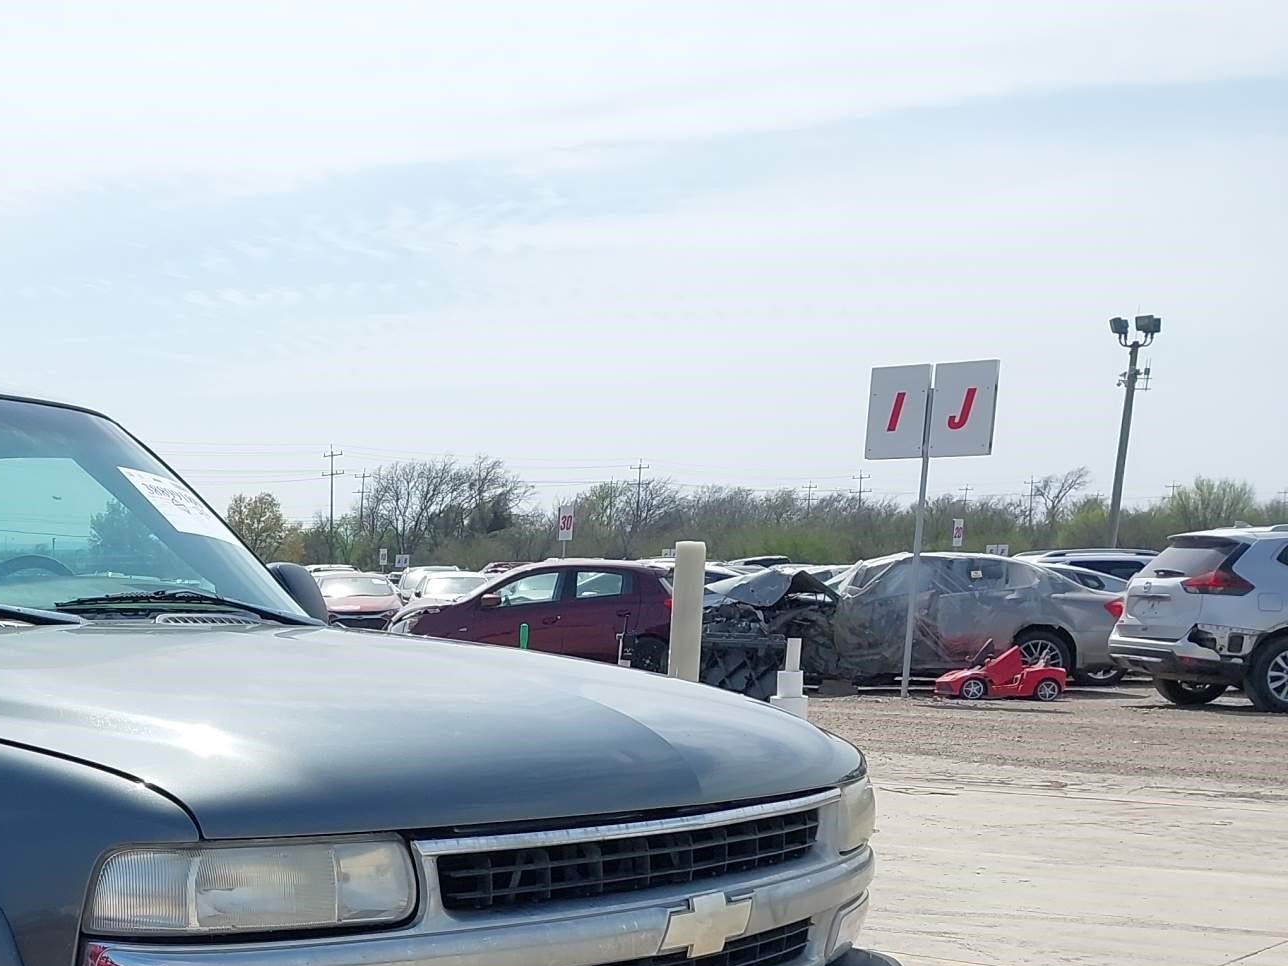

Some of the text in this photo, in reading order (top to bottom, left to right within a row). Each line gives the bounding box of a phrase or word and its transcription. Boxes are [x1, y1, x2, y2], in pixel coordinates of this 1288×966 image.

[886, 392, 906, 432] I
[947, 387, 977, 430] J
[560, 514, 573, 531] 30
